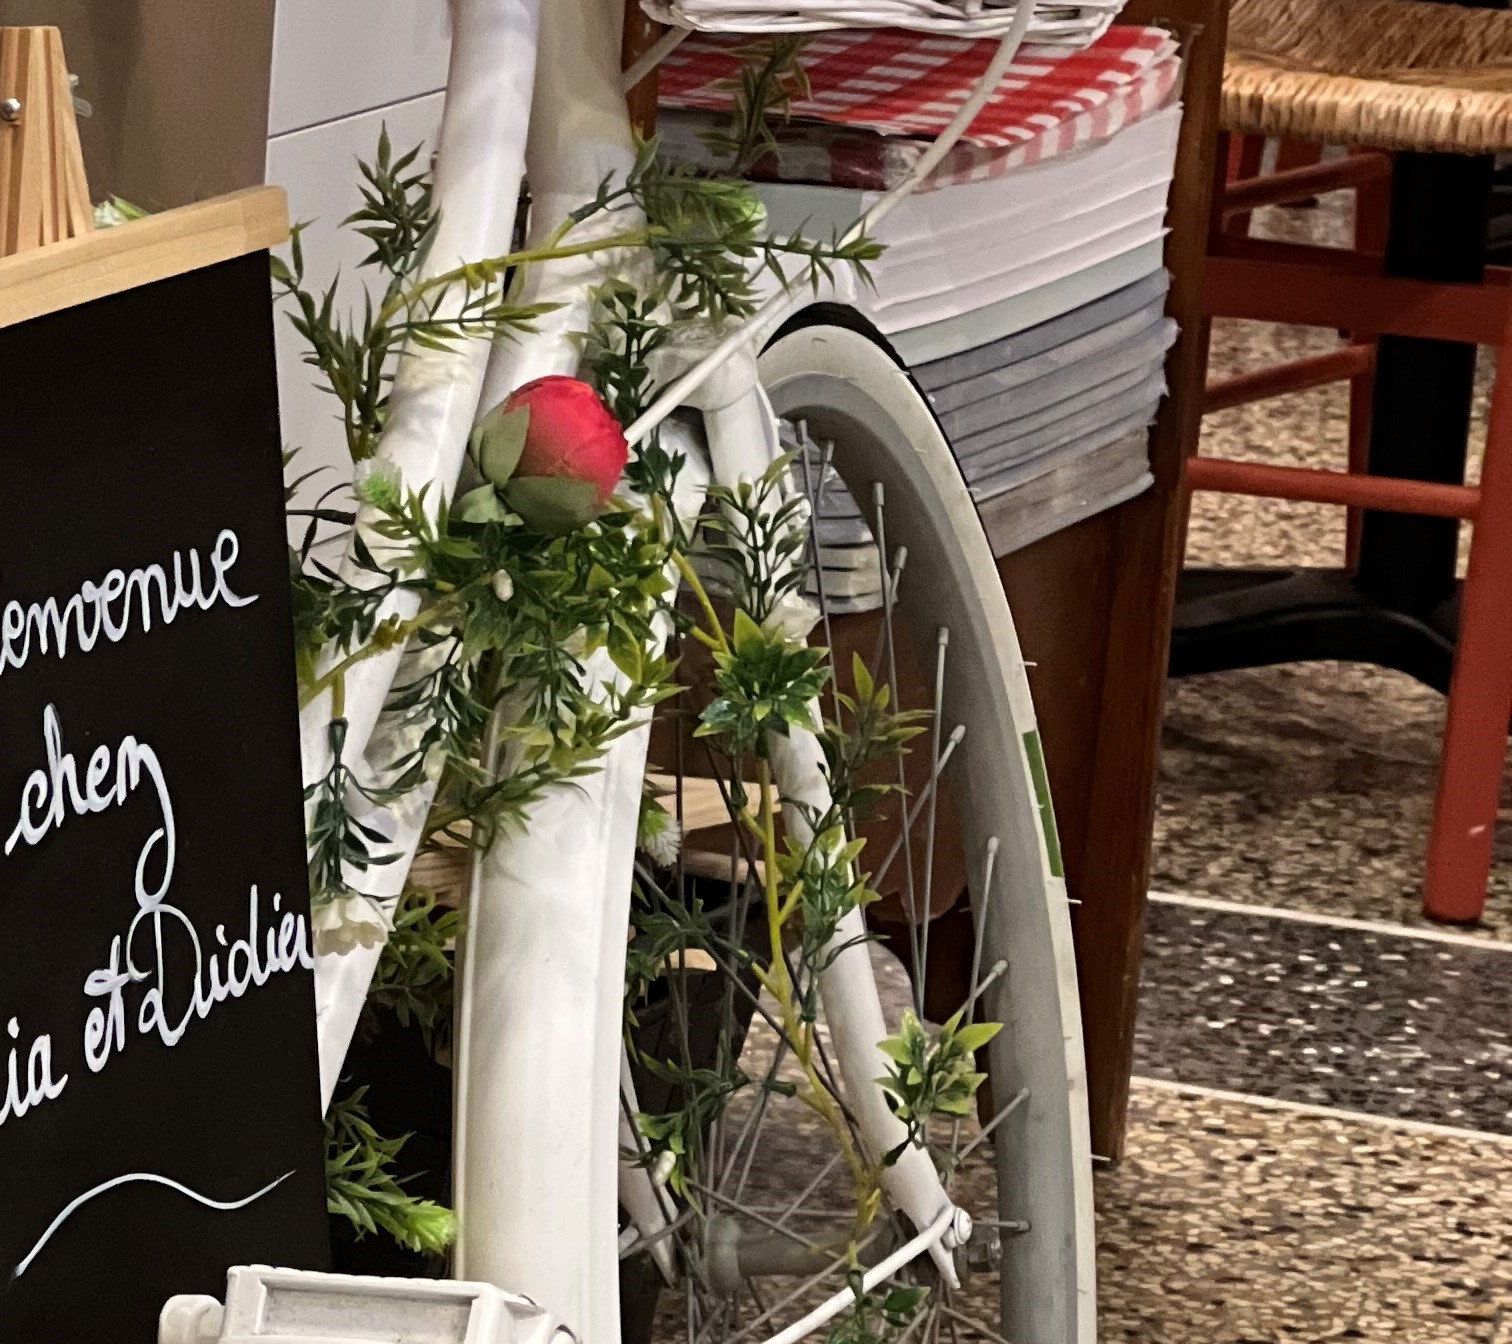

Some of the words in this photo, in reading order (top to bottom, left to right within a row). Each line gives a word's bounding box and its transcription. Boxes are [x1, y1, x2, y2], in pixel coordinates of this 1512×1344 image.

[4, 702, 176, 912] chez
[84, 934, 136, 1073] et
[126, 884, 315, 1047] Didier
